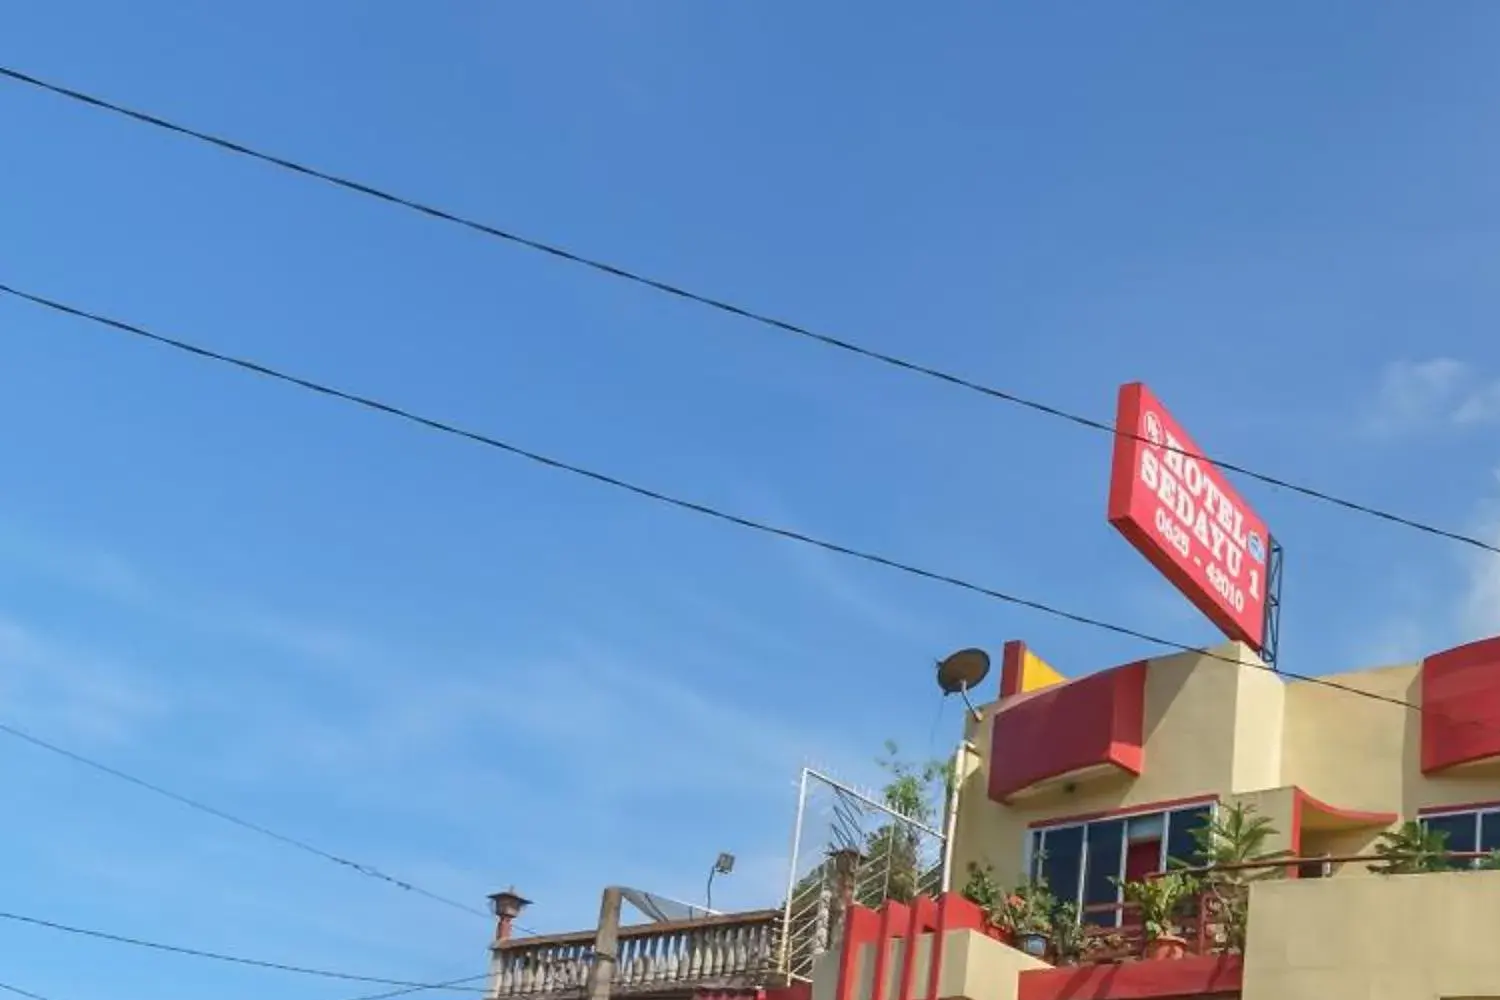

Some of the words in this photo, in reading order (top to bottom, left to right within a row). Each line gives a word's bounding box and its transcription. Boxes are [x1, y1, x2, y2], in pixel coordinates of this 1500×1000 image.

[1141, 449, 1242, 577] SEDAYU
[1249, 568, 1259, 600] 1
[1163, 430, 1247, 550] HOTEL
